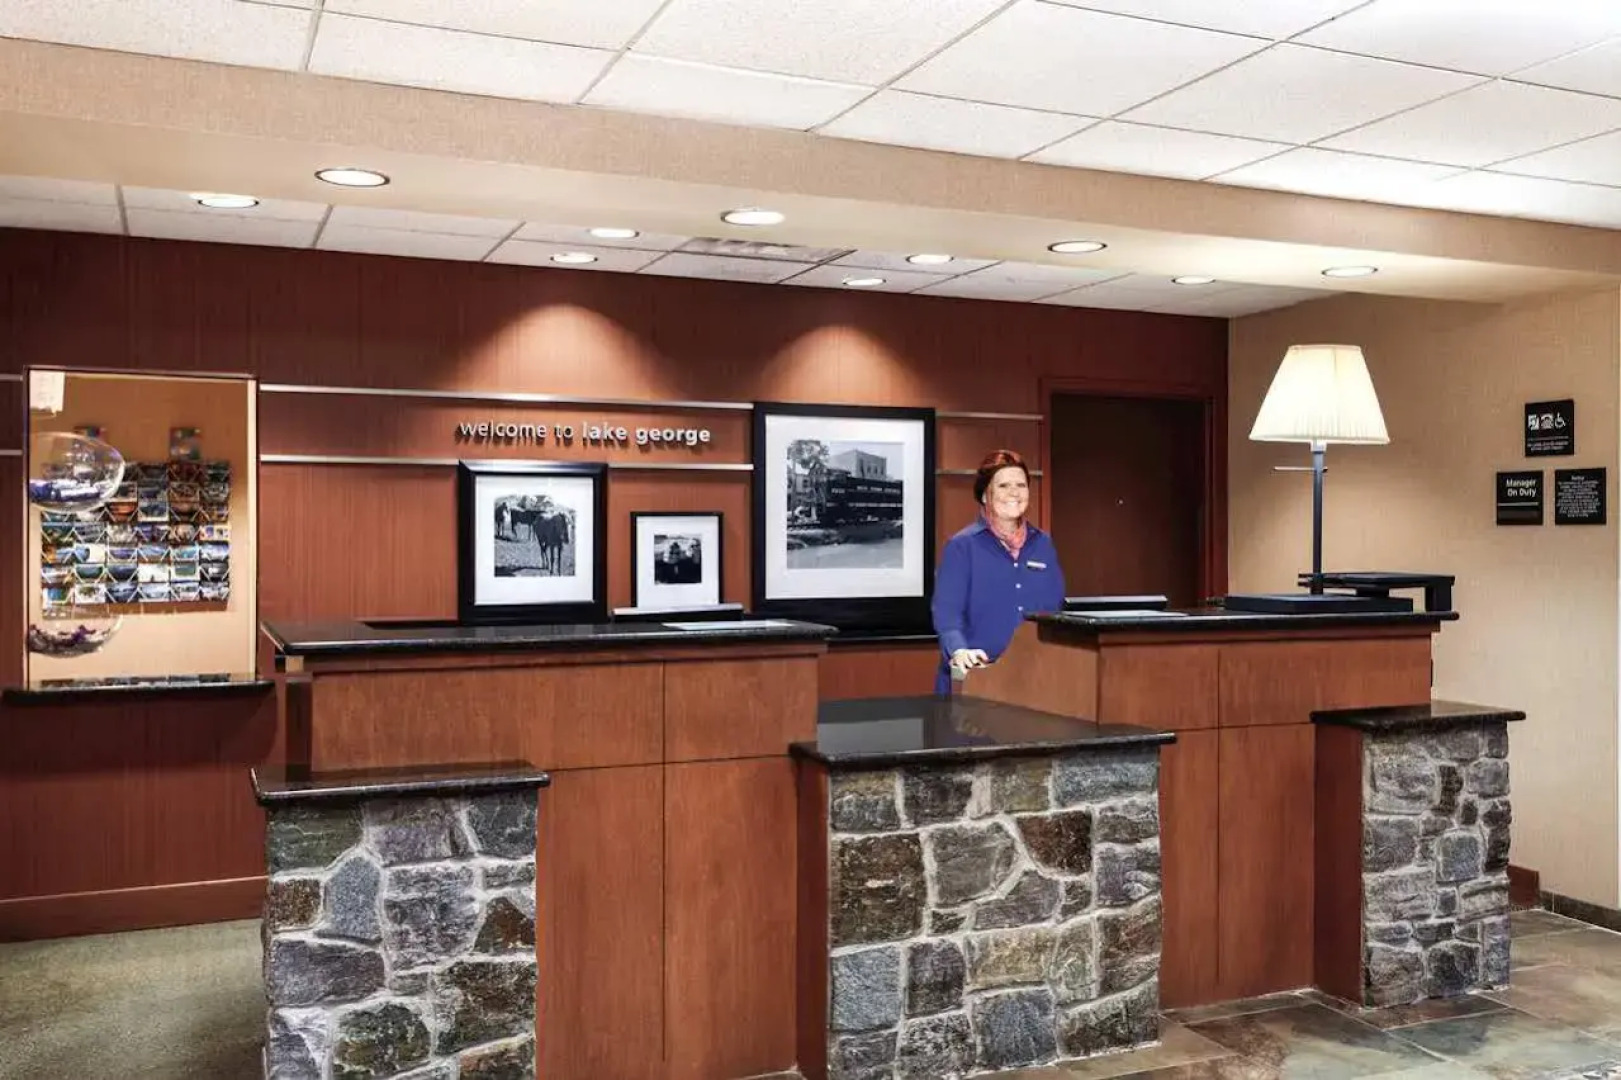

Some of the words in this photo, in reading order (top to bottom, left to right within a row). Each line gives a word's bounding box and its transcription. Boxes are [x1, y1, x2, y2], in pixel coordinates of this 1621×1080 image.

[459, 420, 547, 438] welcome
[556, 423, 574, 439] to
[582, 421, 628, 440] lake
[635, 426, 711, 445] george
[1506, 478, 1536, 488] Manager
[1507, 488, 1518, 497] On
[1519, 488, 1536, 498] Duty
